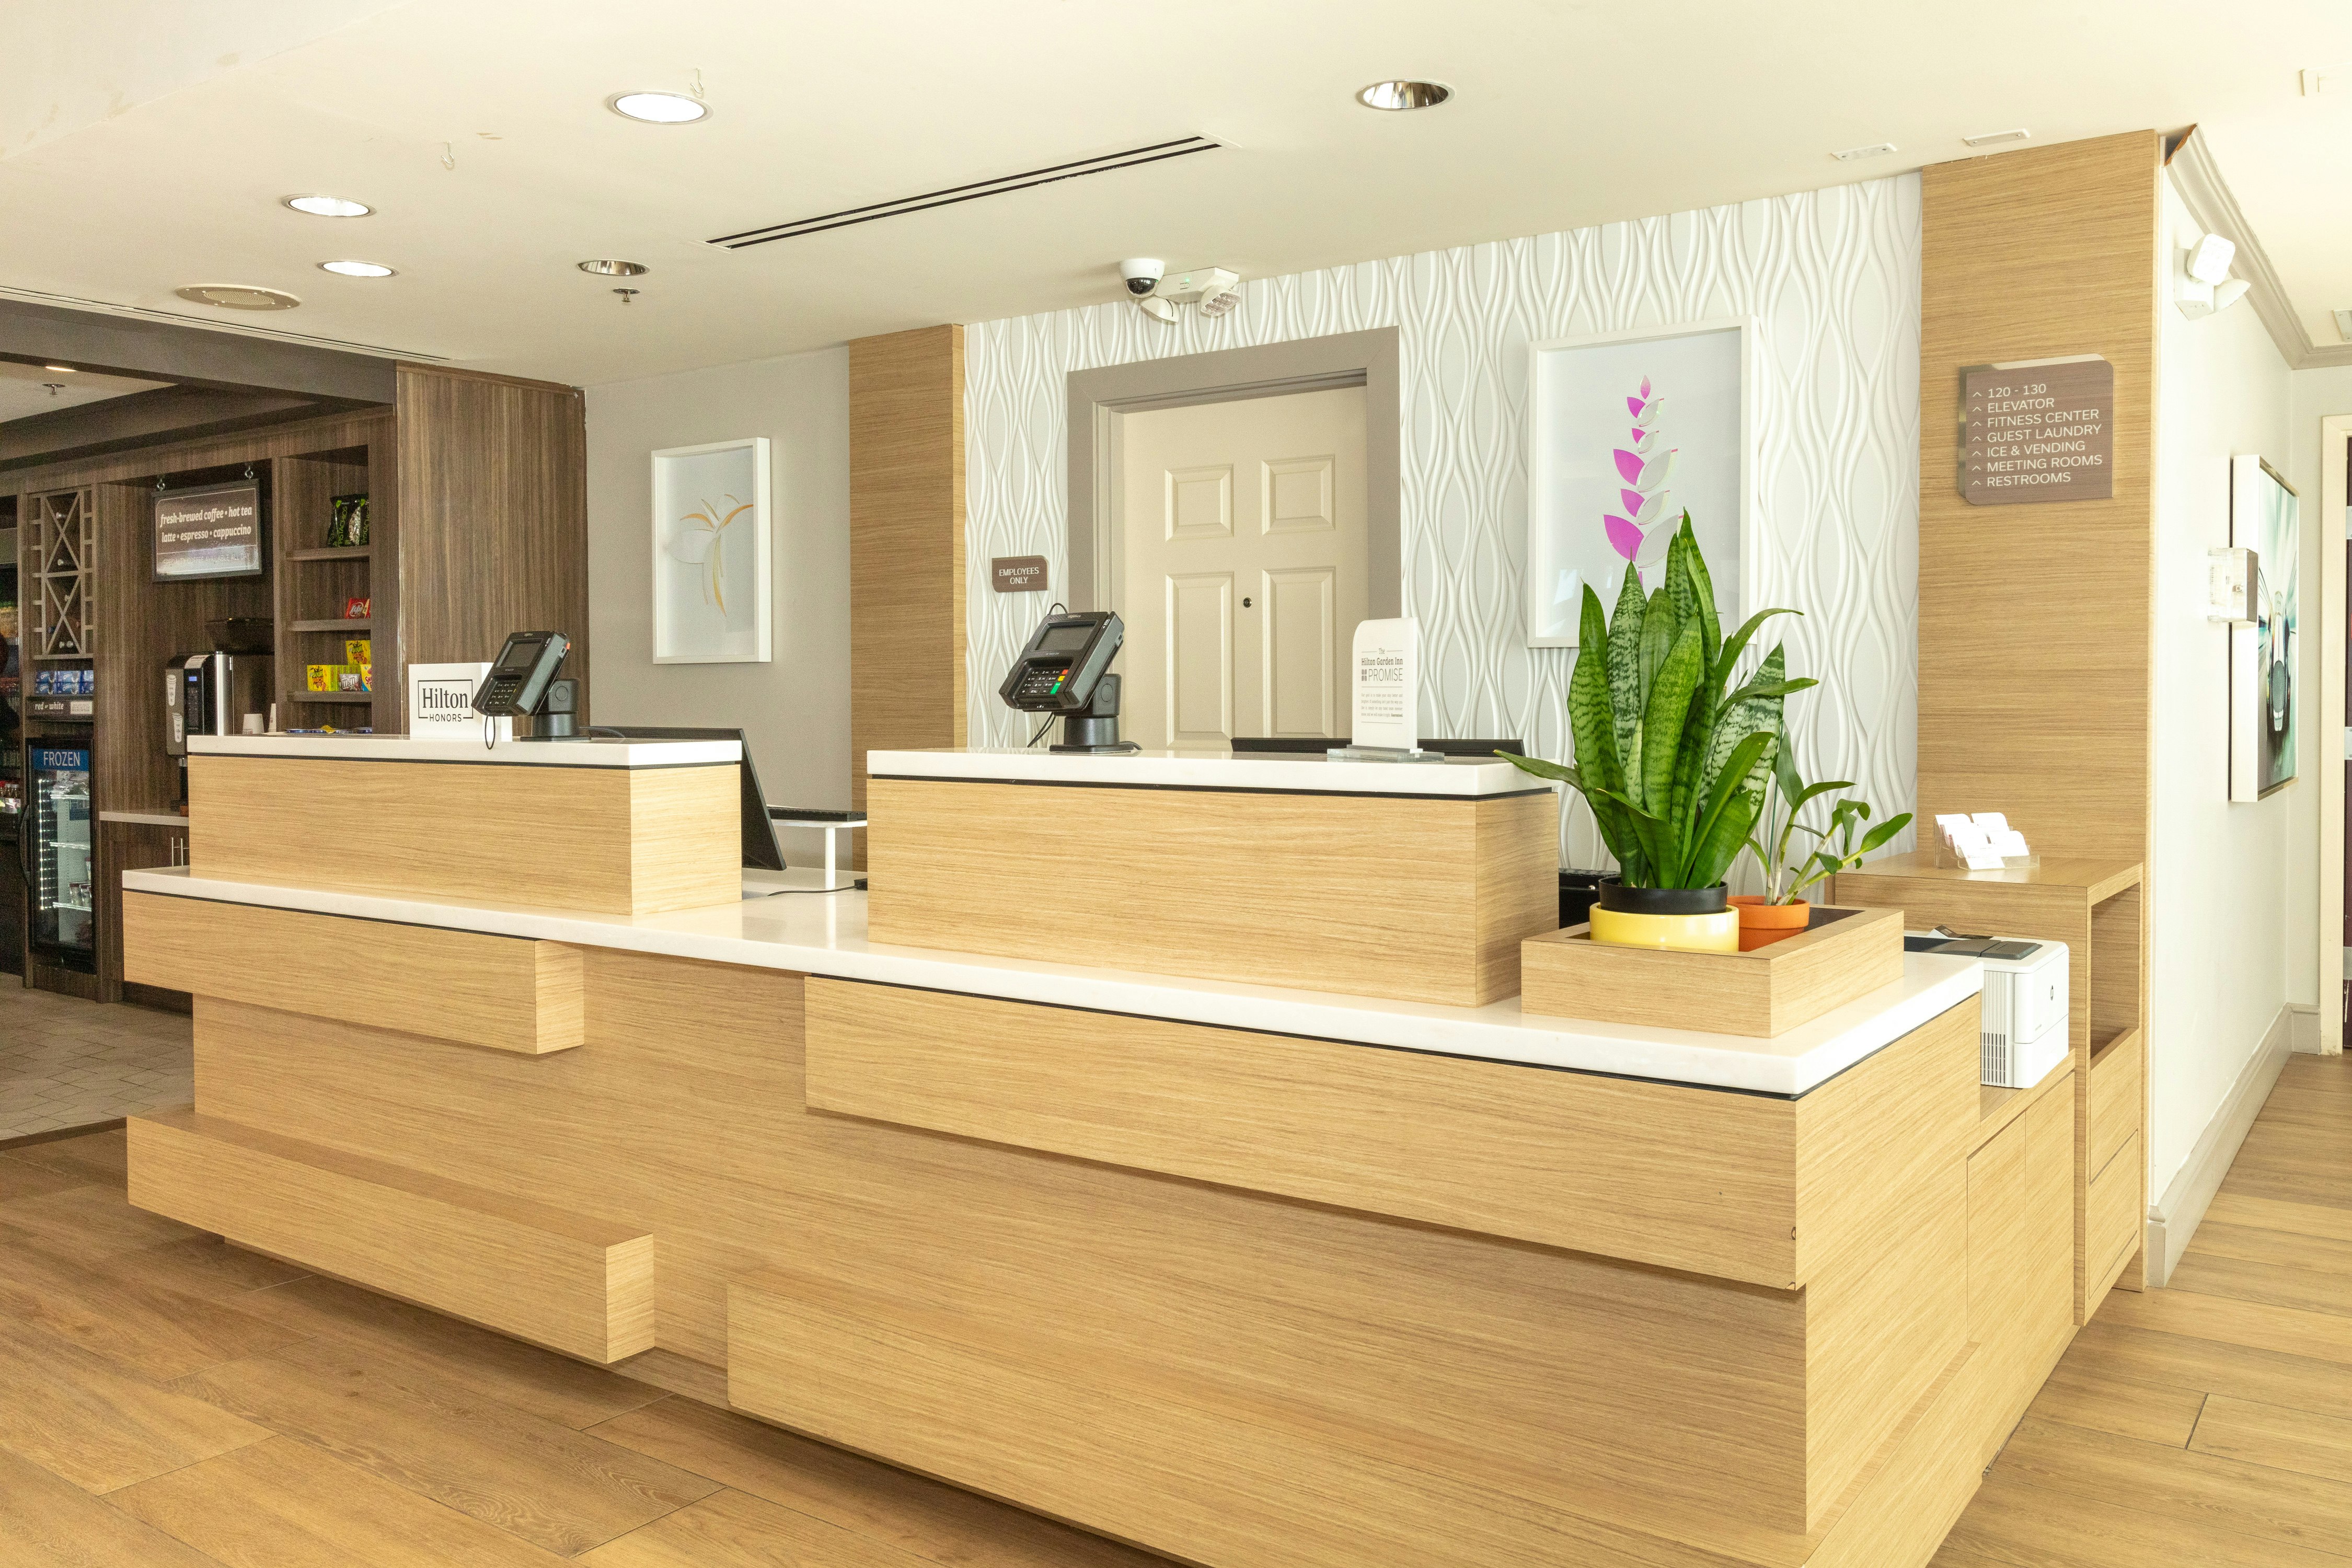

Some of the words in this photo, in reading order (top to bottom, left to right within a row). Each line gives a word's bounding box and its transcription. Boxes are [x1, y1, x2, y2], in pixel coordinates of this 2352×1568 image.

[1988, 387, 2010, 398] 120
[2023, 384, 2046, 395] 130
[1988, 398, 2055, 413] ELEVATOR
[1988, 414, 2041, 428] FITNESS
[2045, 409, 2099, 422] CENTER
[1987, 430, 2032, 442] GUEST
[2036, 424, 2102, 439] LAUNDRY
[1987, 446, 2007, 457] ICE
[2011, 445, 2020, 455] &
[2024, 441, 2085, 455] VENDING
[1987, 458, 2046, 472] MEETING
[2051, 455, 2102, 468] ROOMS
[1987, 472, 2071, 487] RESTROOMS
[160, 510, 203, 527] fresh-brewed
[204, 508, 224, 522] coffee
[228, 506, 240, 517] hot
[241, 506, 252, 515] tea
[338, 506, 348, 544] PISTACHIOS
[162, 532, 176, 543] latte
[180, 530, 209, 543] espresso
[213, 524, 251, 540] cappuccino
[999, 567, 1039, 577] EMPLOYEES
[1377, 657, 1394, 665] Garden
[1368, 668, 1403, 681] PROMISE
[49, 701, 64, 710] white
[422, 687, 468, 708] Hilton
[429, 713, 462, 722] HONORS
[43, 751, 80, 767] FROZEN
